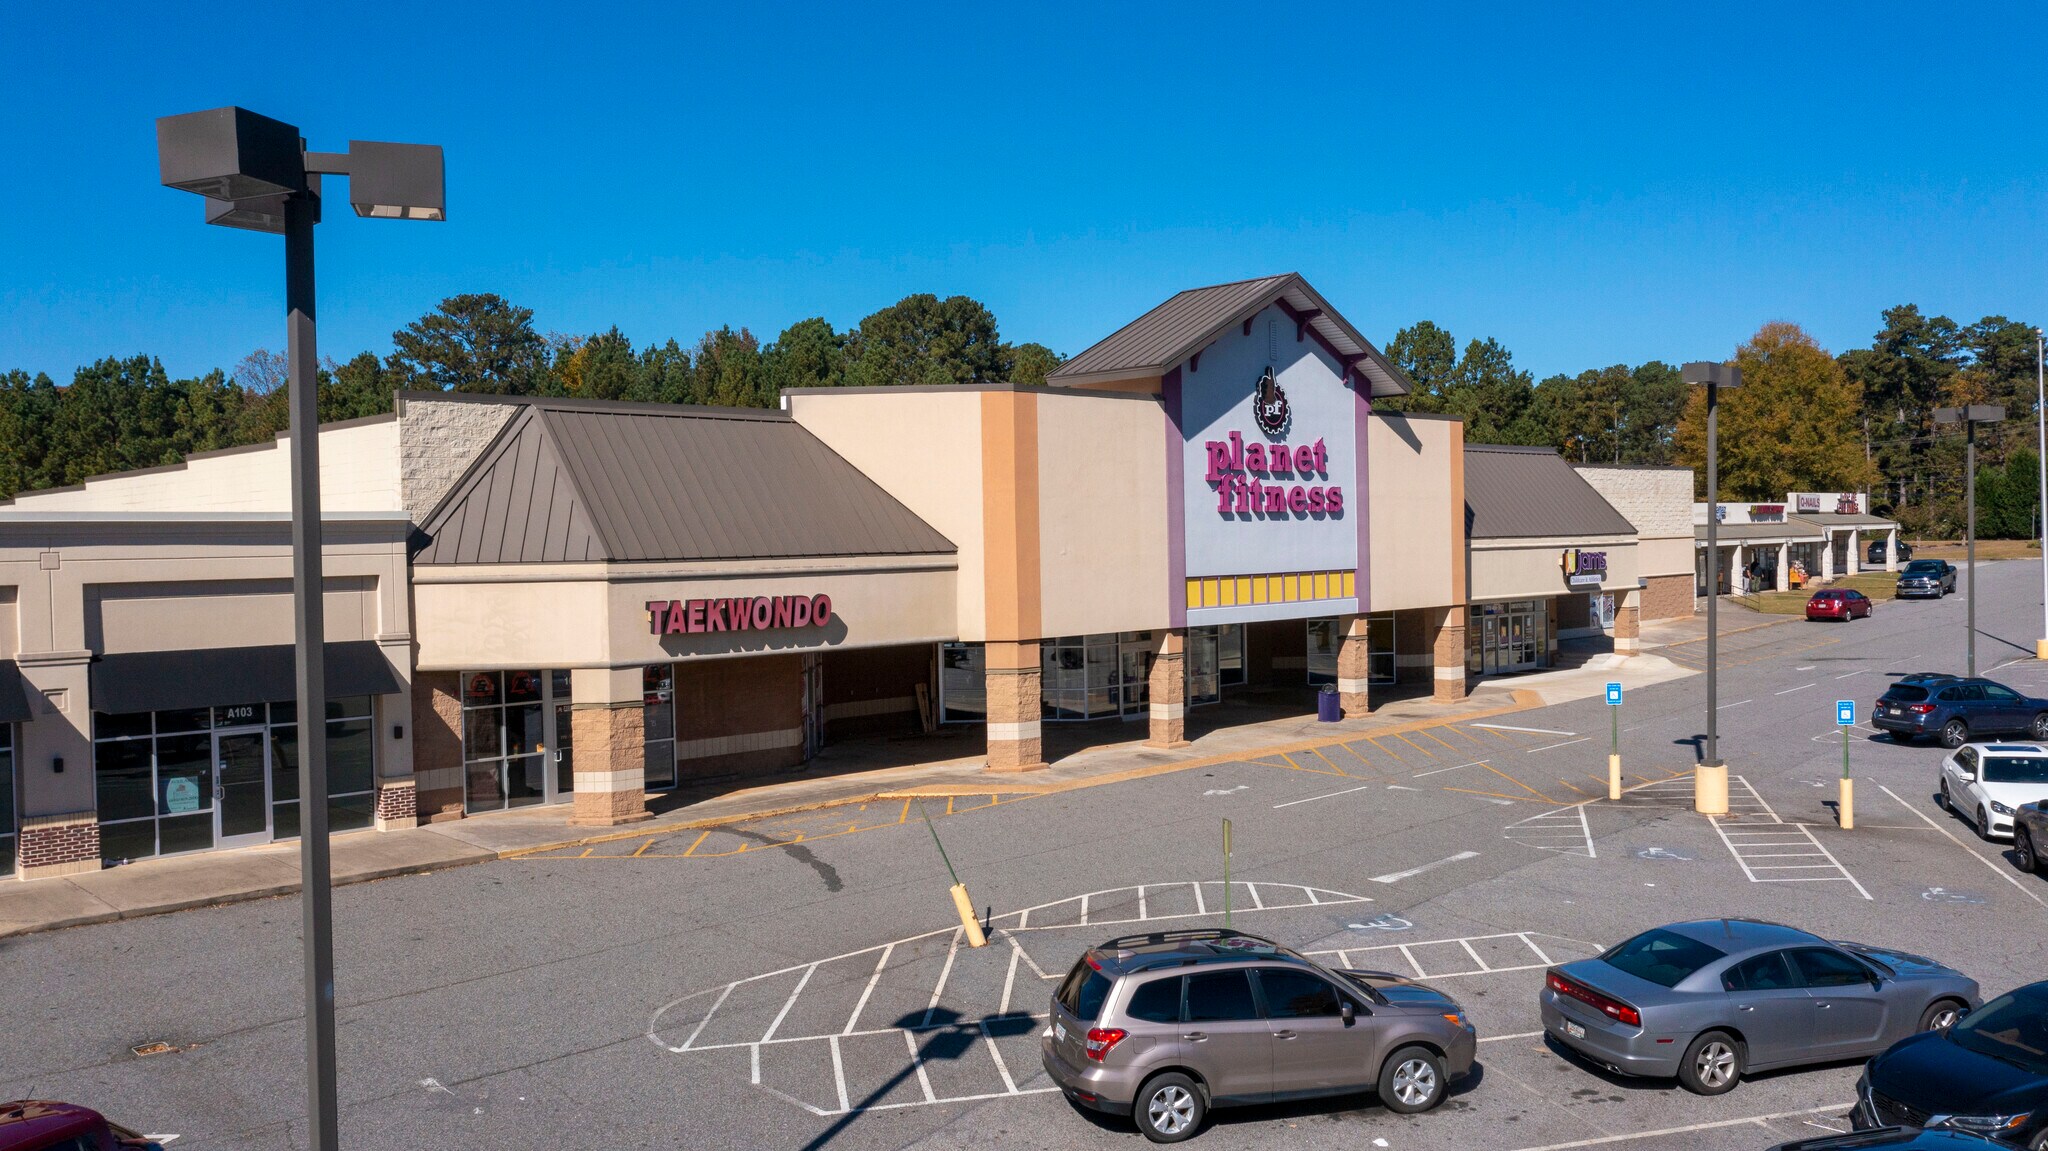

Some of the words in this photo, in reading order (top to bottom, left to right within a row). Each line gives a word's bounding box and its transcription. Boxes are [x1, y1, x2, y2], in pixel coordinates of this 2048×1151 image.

[1264, 400, 1283, 417] pf
[1205, 431, 1327, 481] planet
[1217, 474, 1343, 512] fitness
[1800, 497, 1821, 509] Q-NAILS
[646, 593, 832, 635] TAEKWONDO
[227, 706, 253, 719] A103
